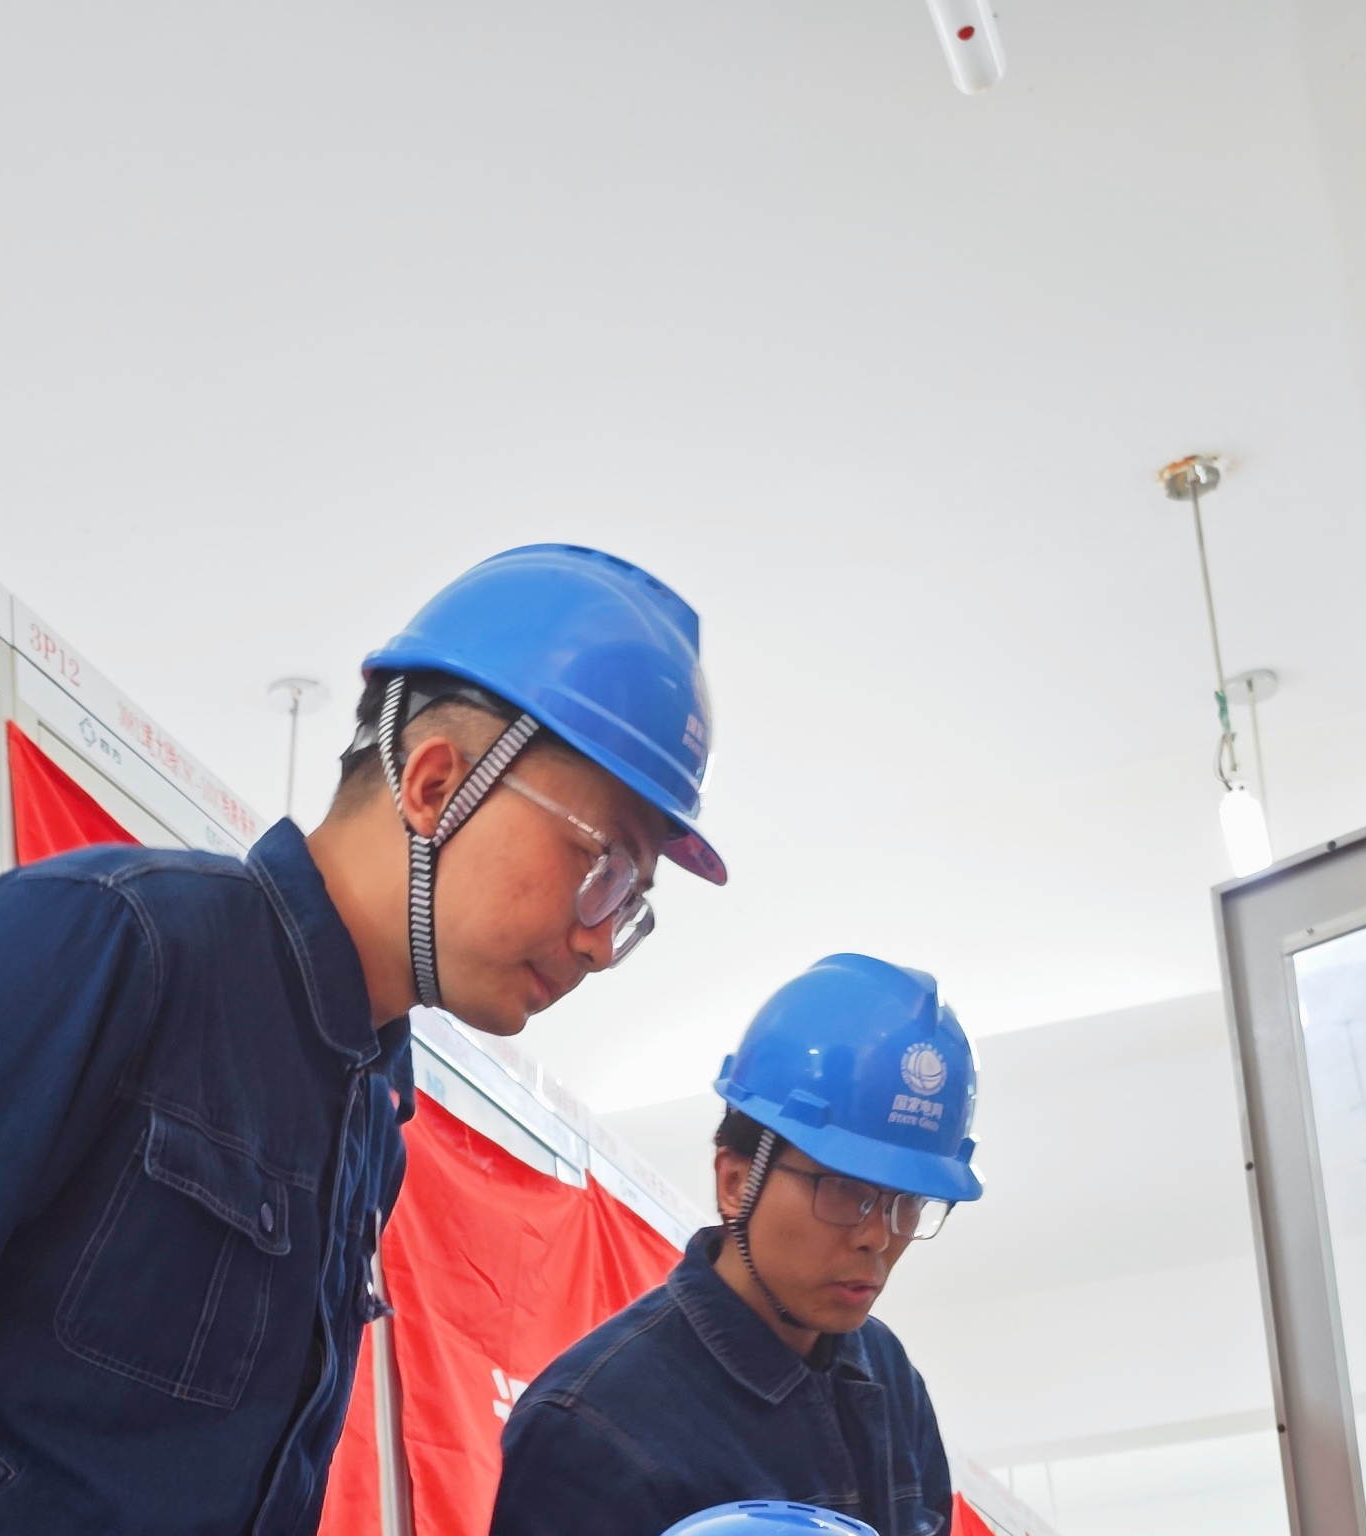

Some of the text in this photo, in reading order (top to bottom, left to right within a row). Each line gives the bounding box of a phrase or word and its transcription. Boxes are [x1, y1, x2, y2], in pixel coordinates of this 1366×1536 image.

[29, 622, 81, 688] 3P12
[892, 1094, 943, 1120] 国家电网
